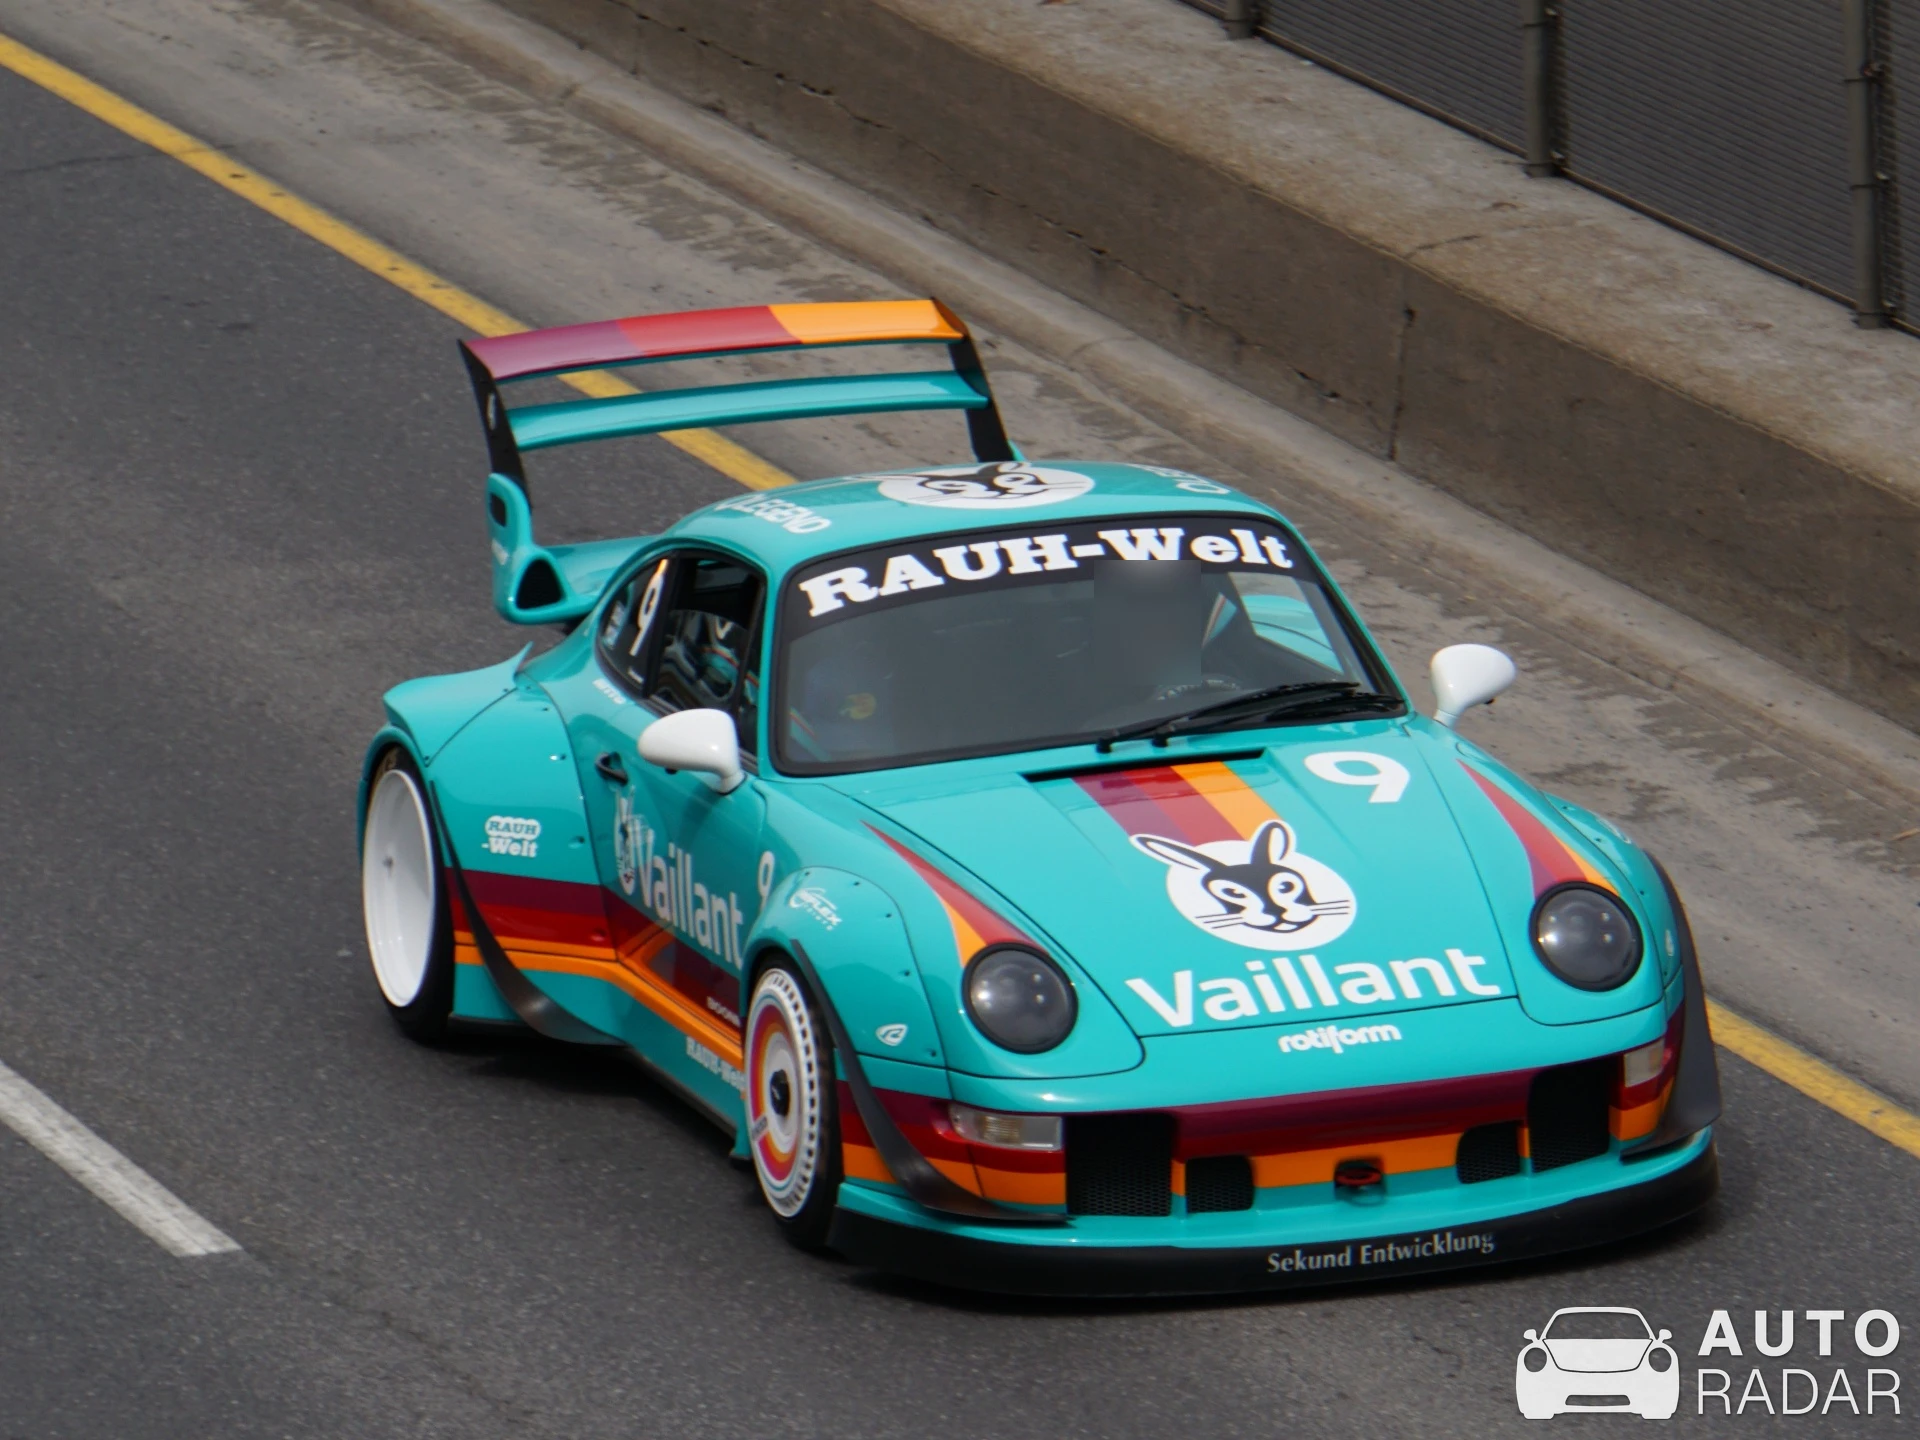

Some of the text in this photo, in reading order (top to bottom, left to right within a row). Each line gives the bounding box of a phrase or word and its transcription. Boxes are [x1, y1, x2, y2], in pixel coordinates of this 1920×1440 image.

[799, 527, 1294, 618] RAUH-Welt
[1303, 750, 1411, 803] 9
[486, 819, 539, 837] RAUH
[632, 815, 744, 973] Vaillant
[757, 850, 776, 914] 9
[1125, 947, 1501, 1028] Vaillant
[1277, 1024, 1403, 1055] rotiform
[1266, 1231, 1496, 1274] Sekund Entwicklung
